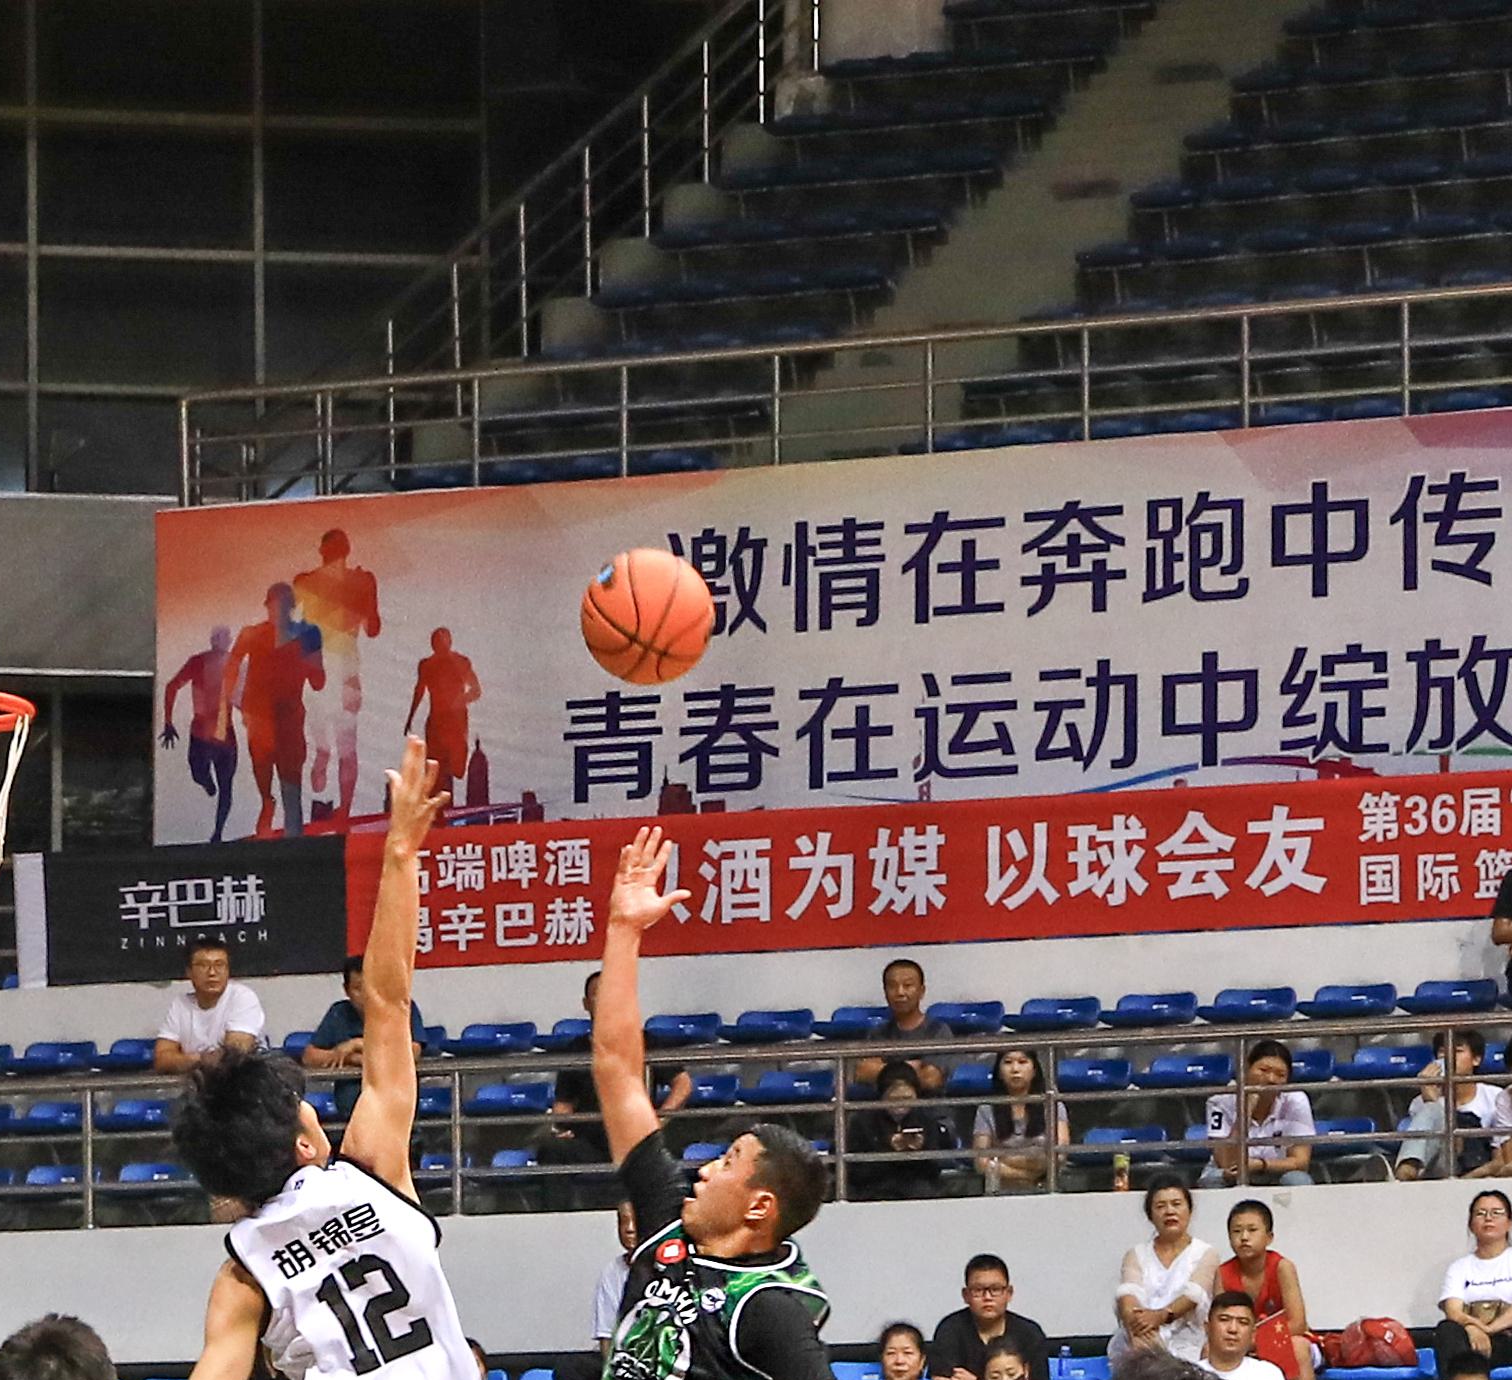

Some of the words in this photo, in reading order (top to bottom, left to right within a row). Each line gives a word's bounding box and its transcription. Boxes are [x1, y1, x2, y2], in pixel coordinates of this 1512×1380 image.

[984, 805, 1329, 911] 以球会友
[119, 874, 266, 929] 辛巴赫
[1211, 1111, 1223, 1130] 3
[316, 1254, 433, 1376] 12
